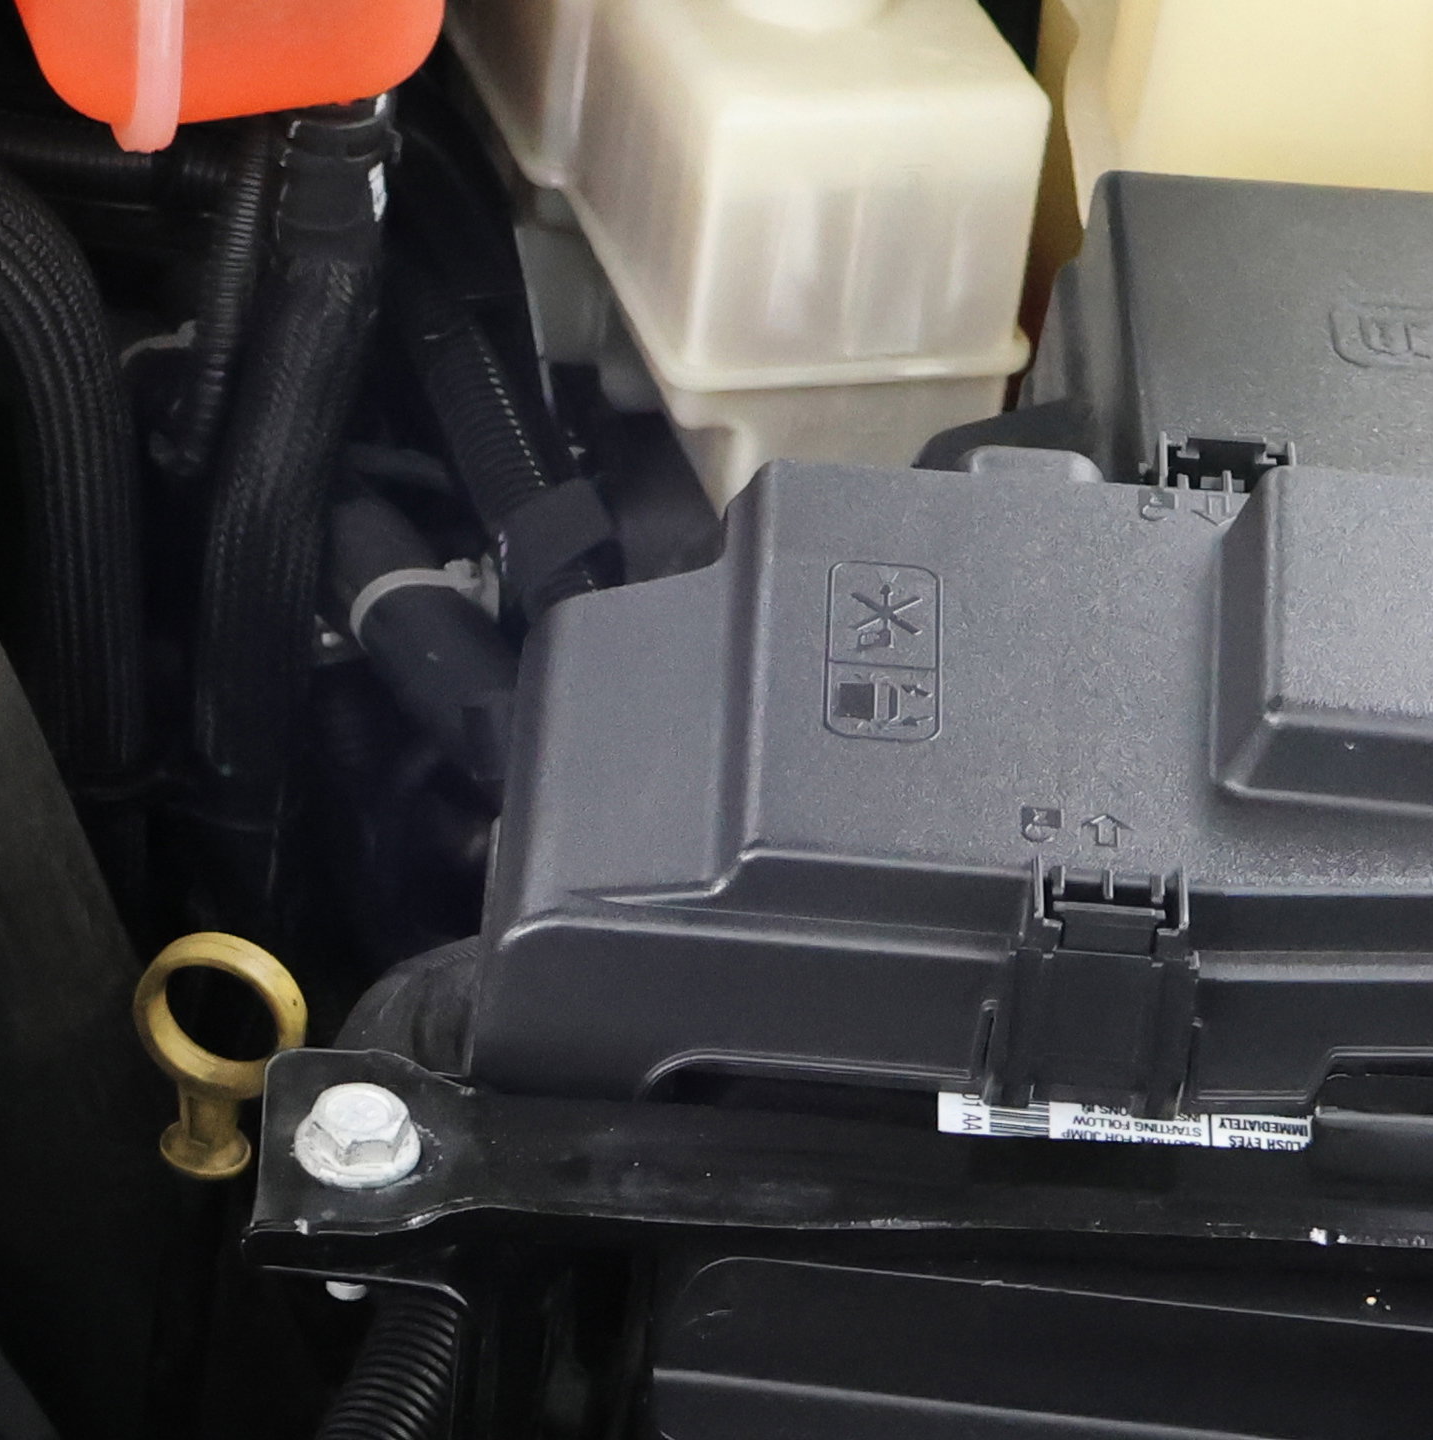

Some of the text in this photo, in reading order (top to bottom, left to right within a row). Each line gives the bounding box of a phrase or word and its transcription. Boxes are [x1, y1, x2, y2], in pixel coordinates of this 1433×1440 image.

[961, 1111, 982, 1131] AA
[1072, 1115, 1203, 1138] STARTING FOLLOW
[1218, 1117, 1309, 1137] IMMEDIATELY
[1266, 1137, 1309, 1152] LUSH
